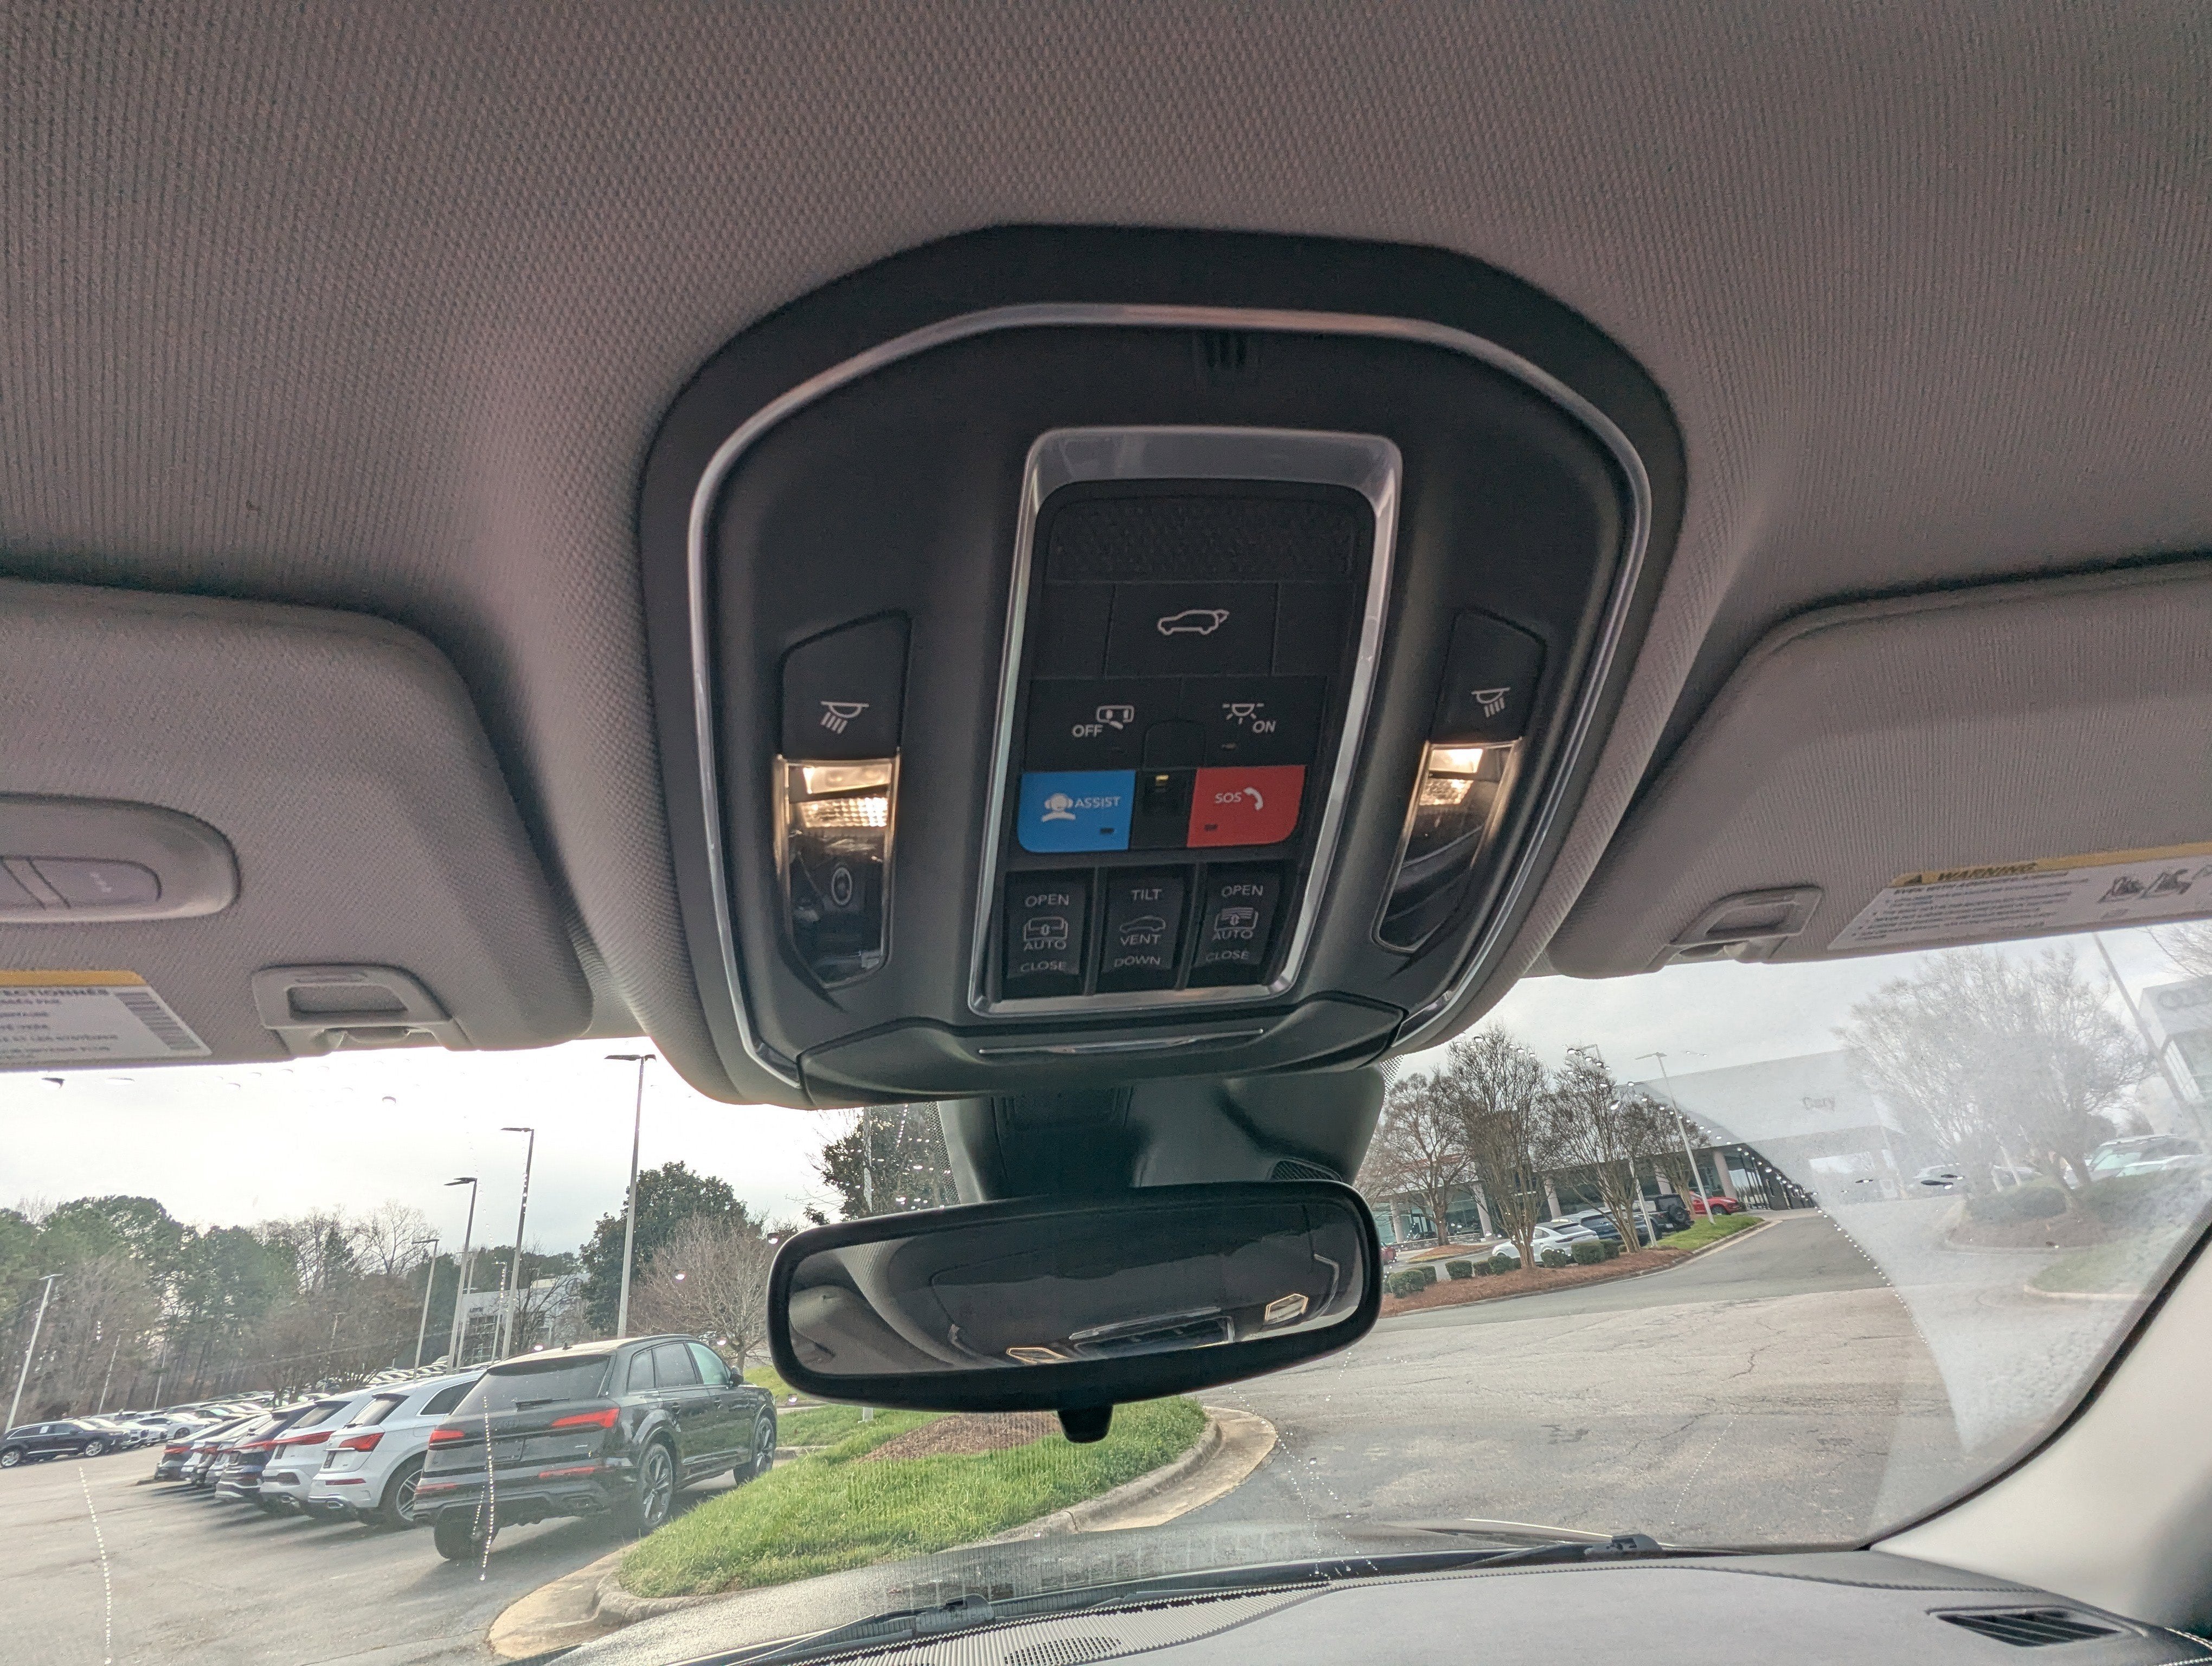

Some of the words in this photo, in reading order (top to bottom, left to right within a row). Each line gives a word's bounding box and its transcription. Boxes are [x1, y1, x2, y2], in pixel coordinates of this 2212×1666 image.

[1071, 723, 1104, 738] OFF
[1252, 720, 1276, 734] ON
[1074, 796, 1121, 809] ASSIST
[1214, 791, 1242, 804] SOS
[1131, 888, 1162, 901] TILT
[1220, 884, 1264, 898] OPEN
[1025, 893, 1070, 908] OPEN
[1119, 933, 1161, 946] VENT
[1211, 929, 1254, 941] AUTO
[1024, 939, 1067, 951] AUTO
[1114, 954, 1161, 968] DOWN
[1205, 950, 1250, 963] CLOSE
[1020, 960, 1067, 973] CLOSE
